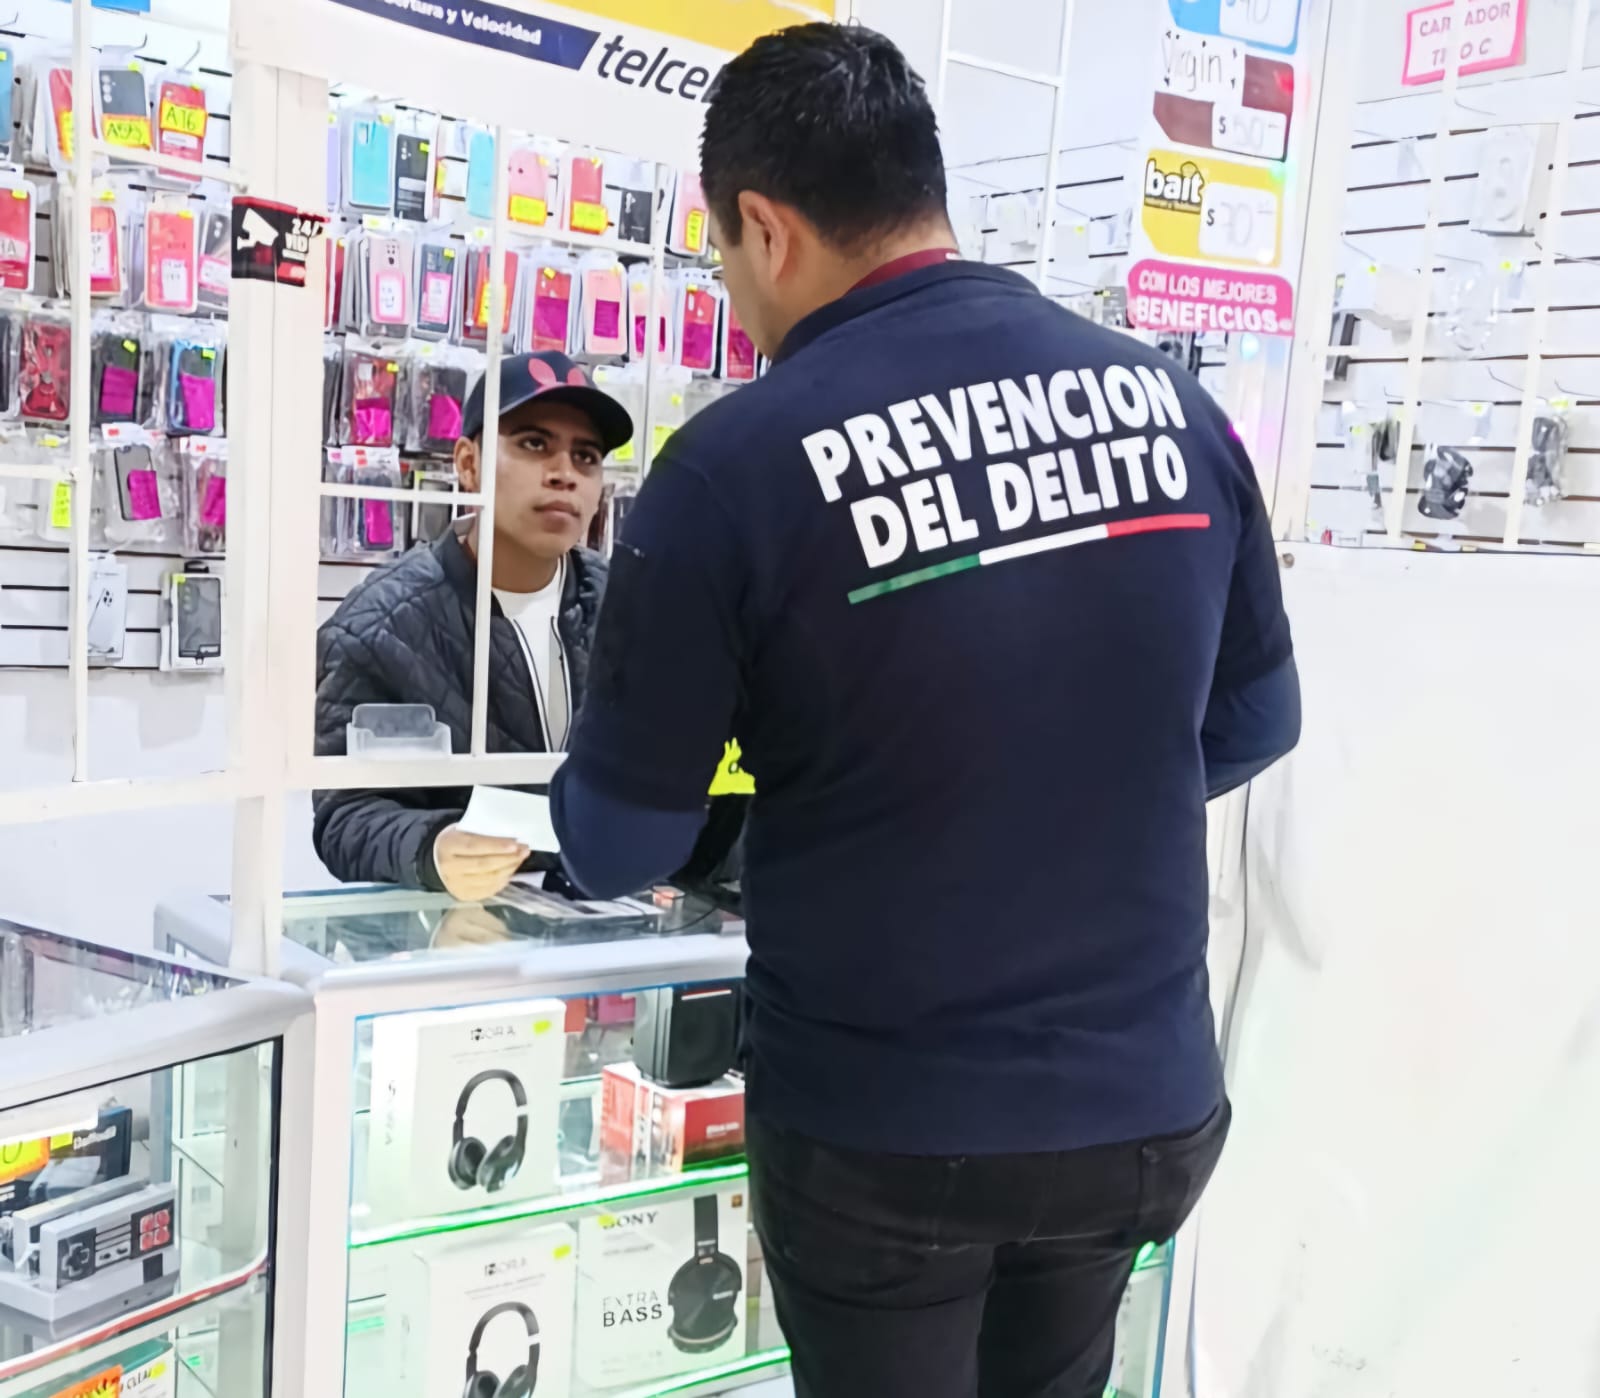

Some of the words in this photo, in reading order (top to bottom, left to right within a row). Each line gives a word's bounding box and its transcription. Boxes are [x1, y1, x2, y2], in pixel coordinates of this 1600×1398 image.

[446, 8, 458, 25] y
[460, 9, 542, 45] Velocidad
[1419, 2, 1511, 37] CARADOR
[1432, 42, 1473, 67] TIO
[1479, 38, 1493, 55] C
[1145, 158, 1204, 205] bait
[1138, 270, 1167, 294] CON
[1168, 274, 1200, 298] LOS
[1202, 277, 1277, 306] MEJORES
[1135, 295, 1279, 333] BENEFICIOS
[802, 365, 1187, 503] PREVENCION
[850, 473, 980, 568] DEL
[986, 434, 1188, 532] DELITO
[603, 1210, 659, 1230] ONY
[603, 1303, 663, 1328] BASS
